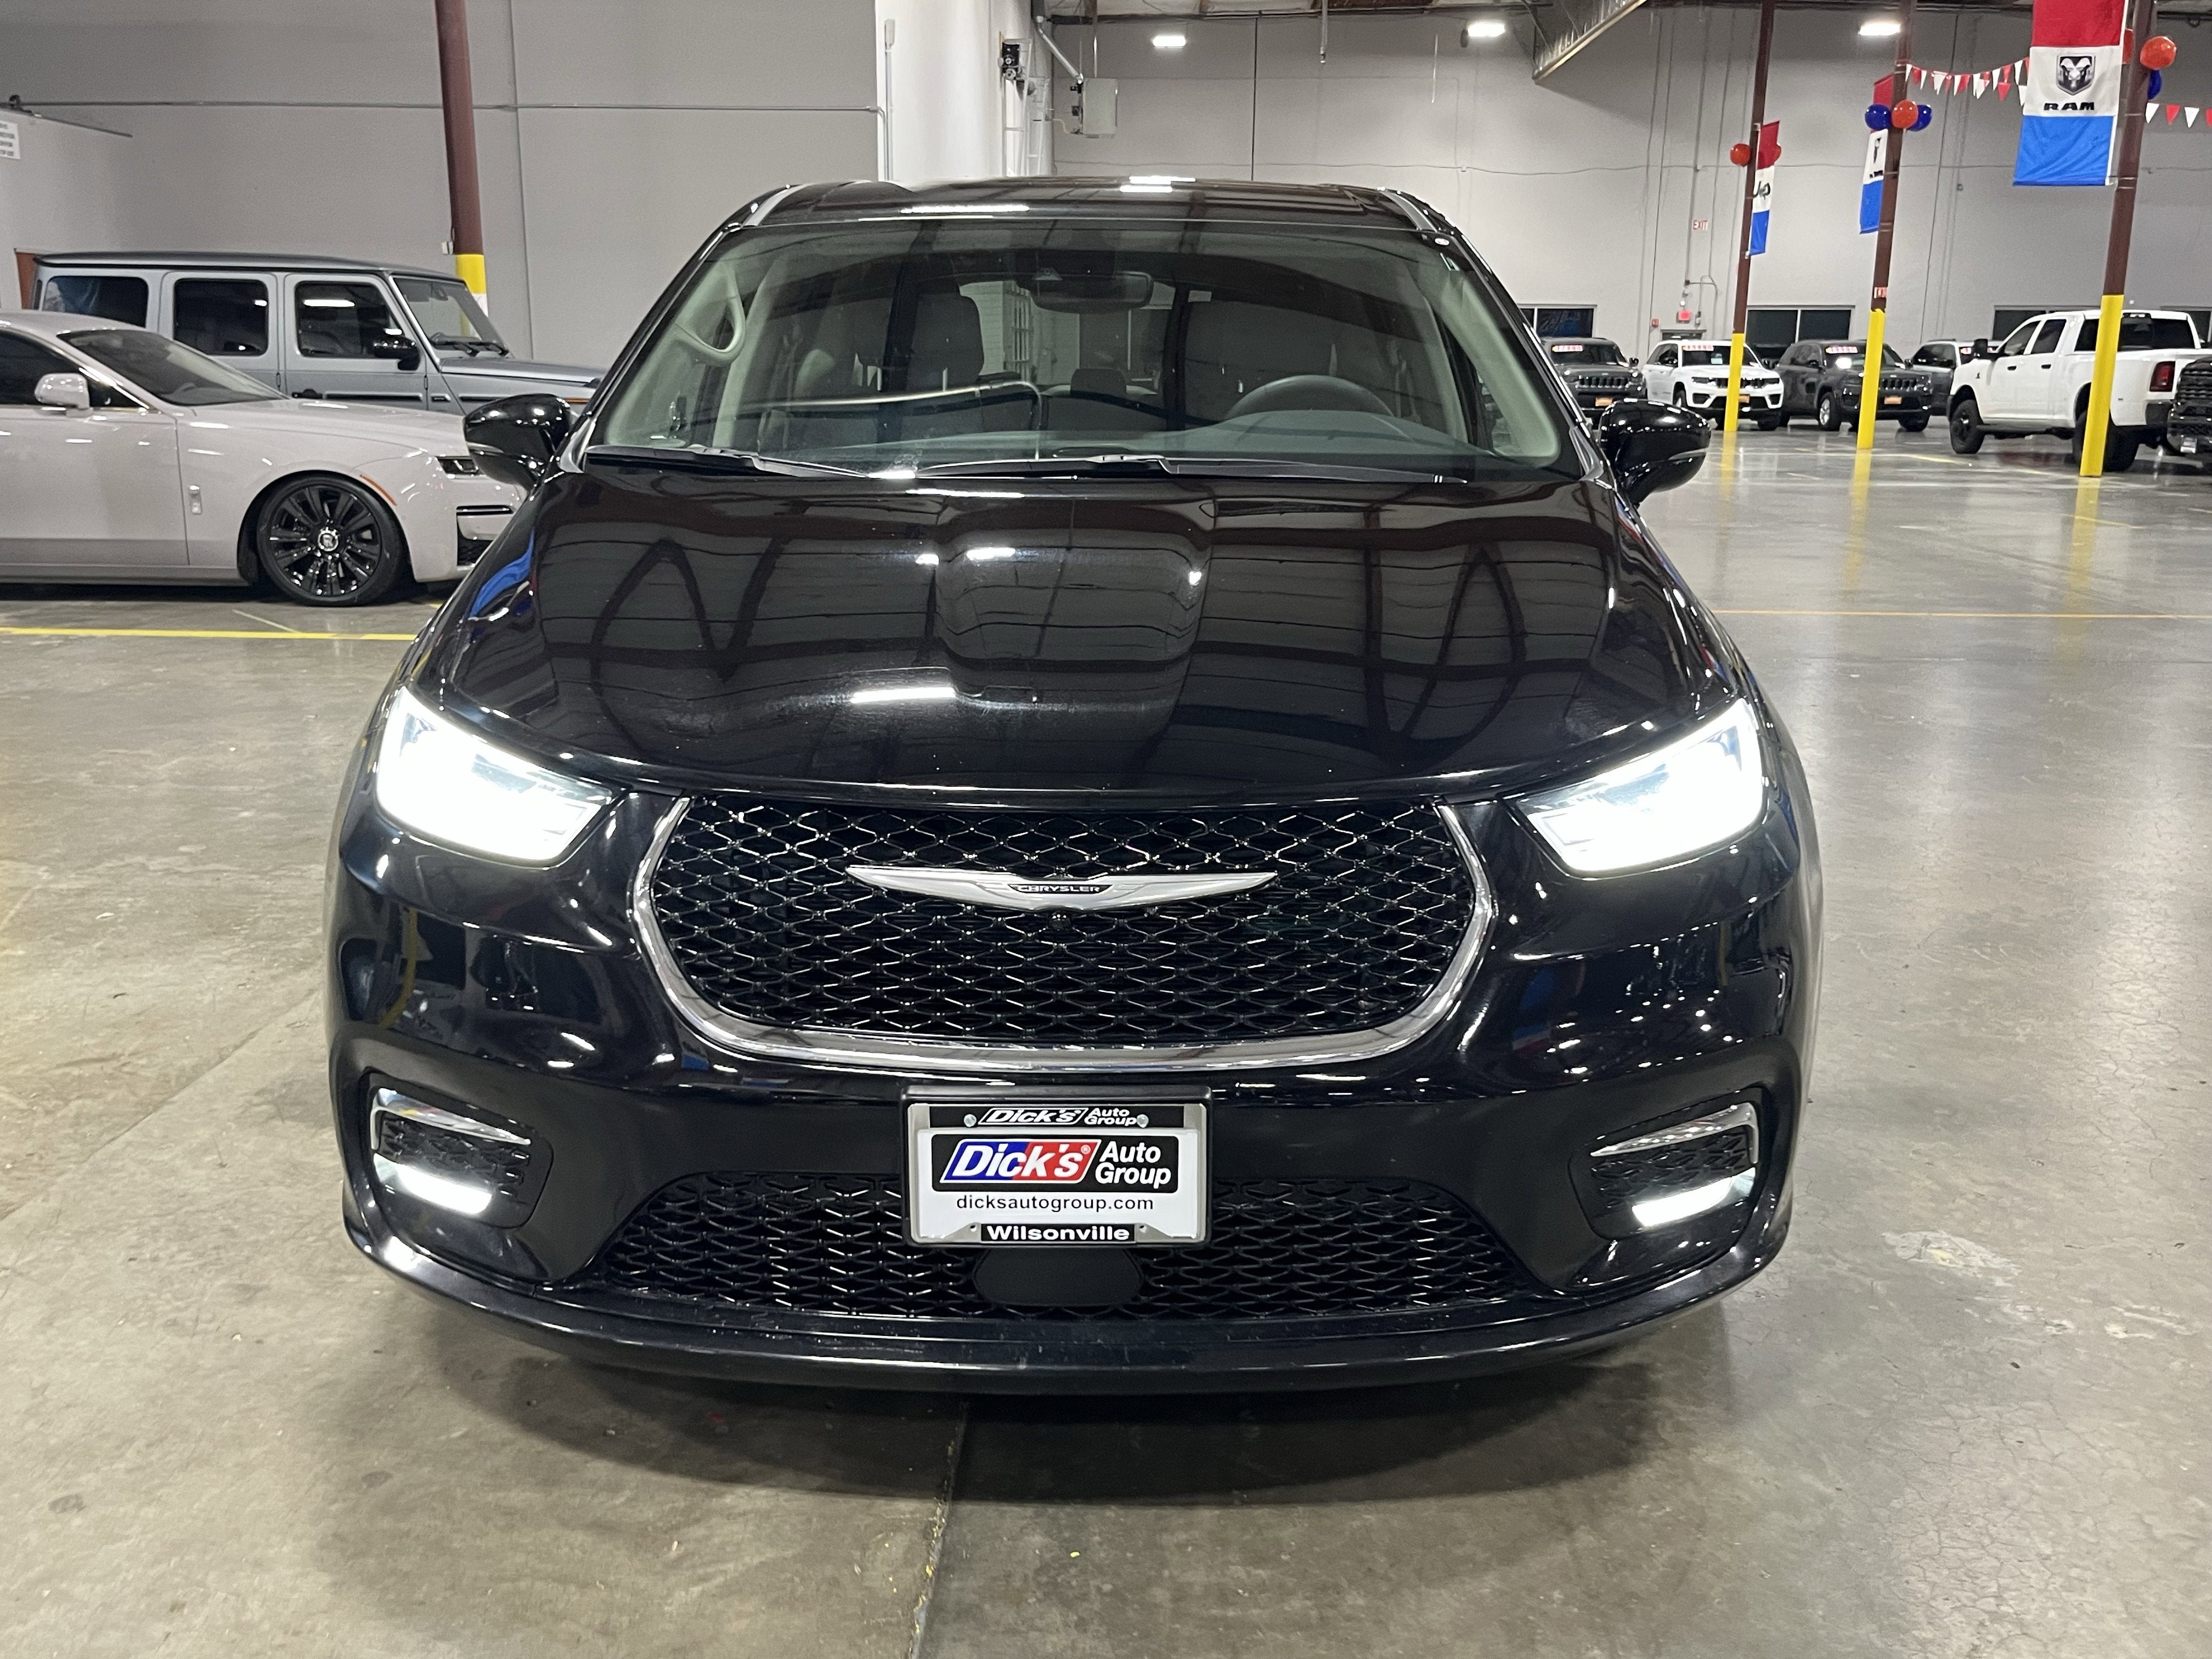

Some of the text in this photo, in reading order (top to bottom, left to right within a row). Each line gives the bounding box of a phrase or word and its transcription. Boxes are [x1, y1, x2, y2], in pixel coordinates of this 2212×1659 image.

[2044, 102, 2095, 110] RAM
[1693, 220, 1708, 230] EXIT
[1088, 1108, 1130, 1117] Auto
[1084, 1116, 1137, 1126] Group
[1099, 1141, 1161, 1163] Auto
[952, 1143, 1083, 1177] Dick's
[1095, 1163, 1172, 1189] Group
[957, 1195, 1154, 1212] dicksautogroup.com
[986, 1225, 1130, 1240] Wilsonville
